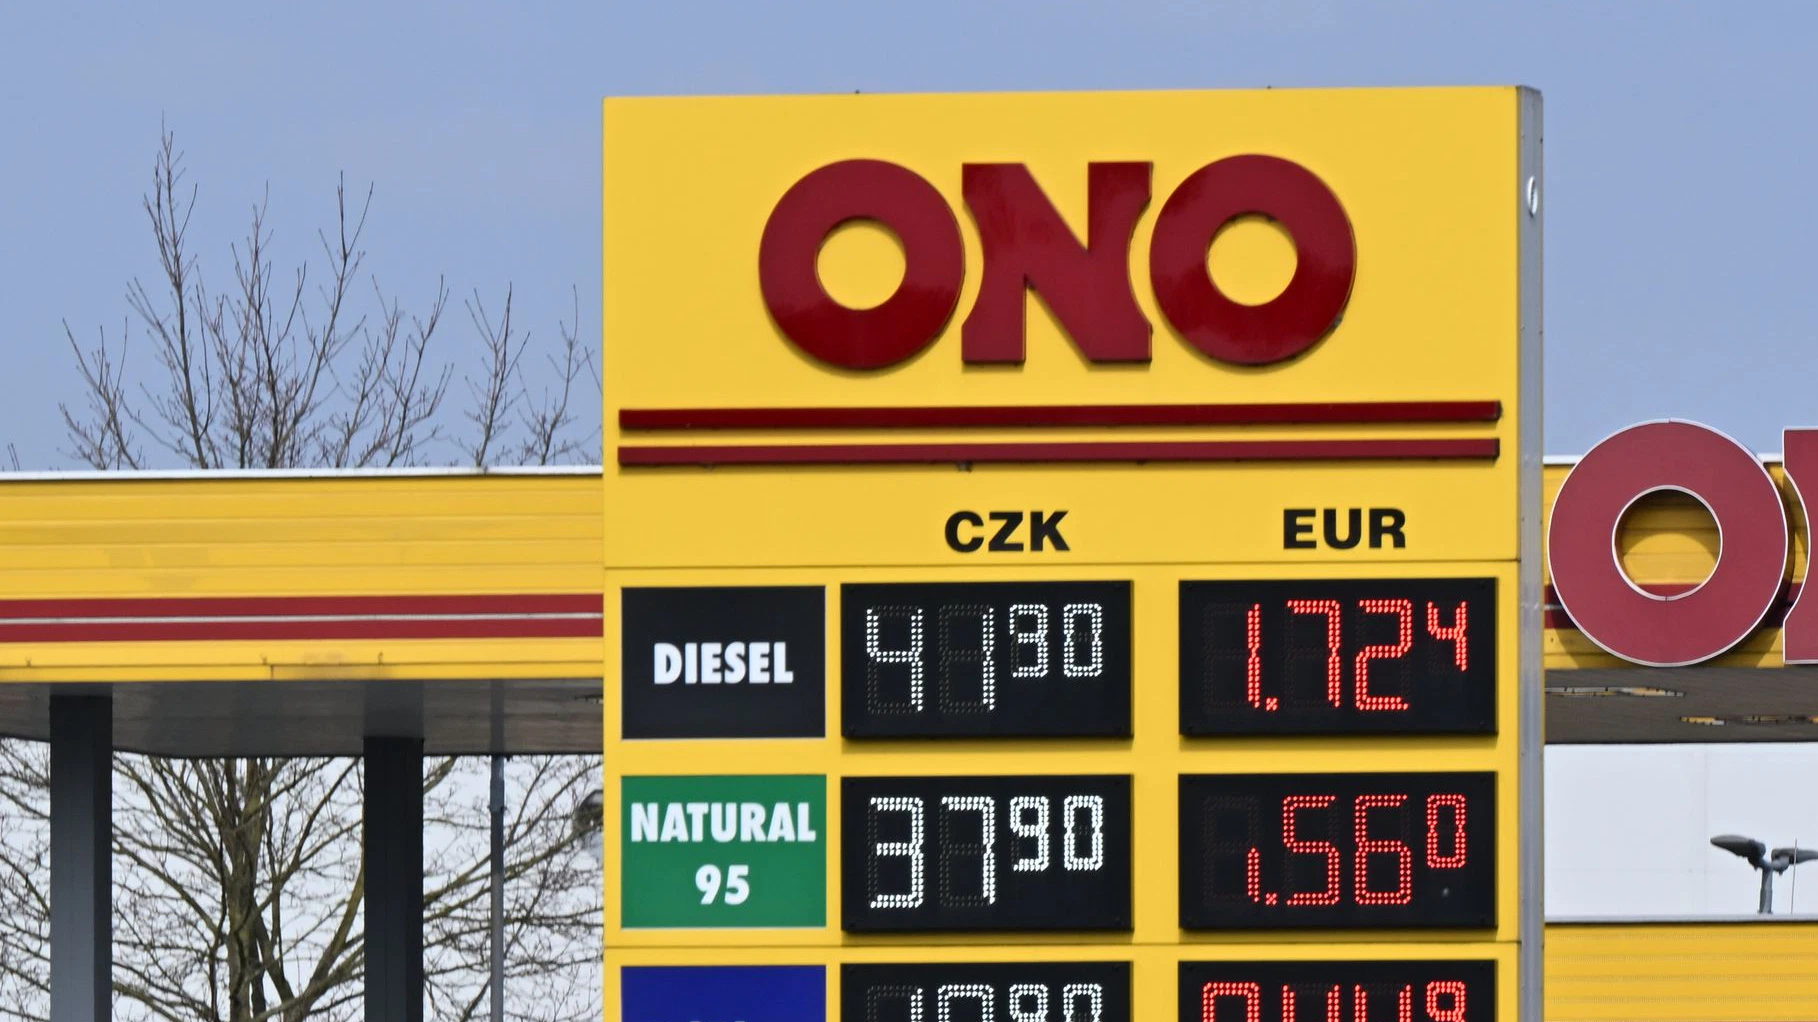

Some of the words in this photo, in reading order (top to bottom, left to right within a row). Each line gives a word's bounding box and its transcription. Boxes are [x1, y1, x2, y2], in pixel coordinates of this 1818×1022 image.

[758, 153, 1356, 371] ONO
[944, 510, 1071, 553] CZK
[1282, 508, 1407, 550] EUR
[653, 641, 794, 684] DIESEL
[631, 802, 817, 843] NATURAL
[695, 864, 750, 906] 95
